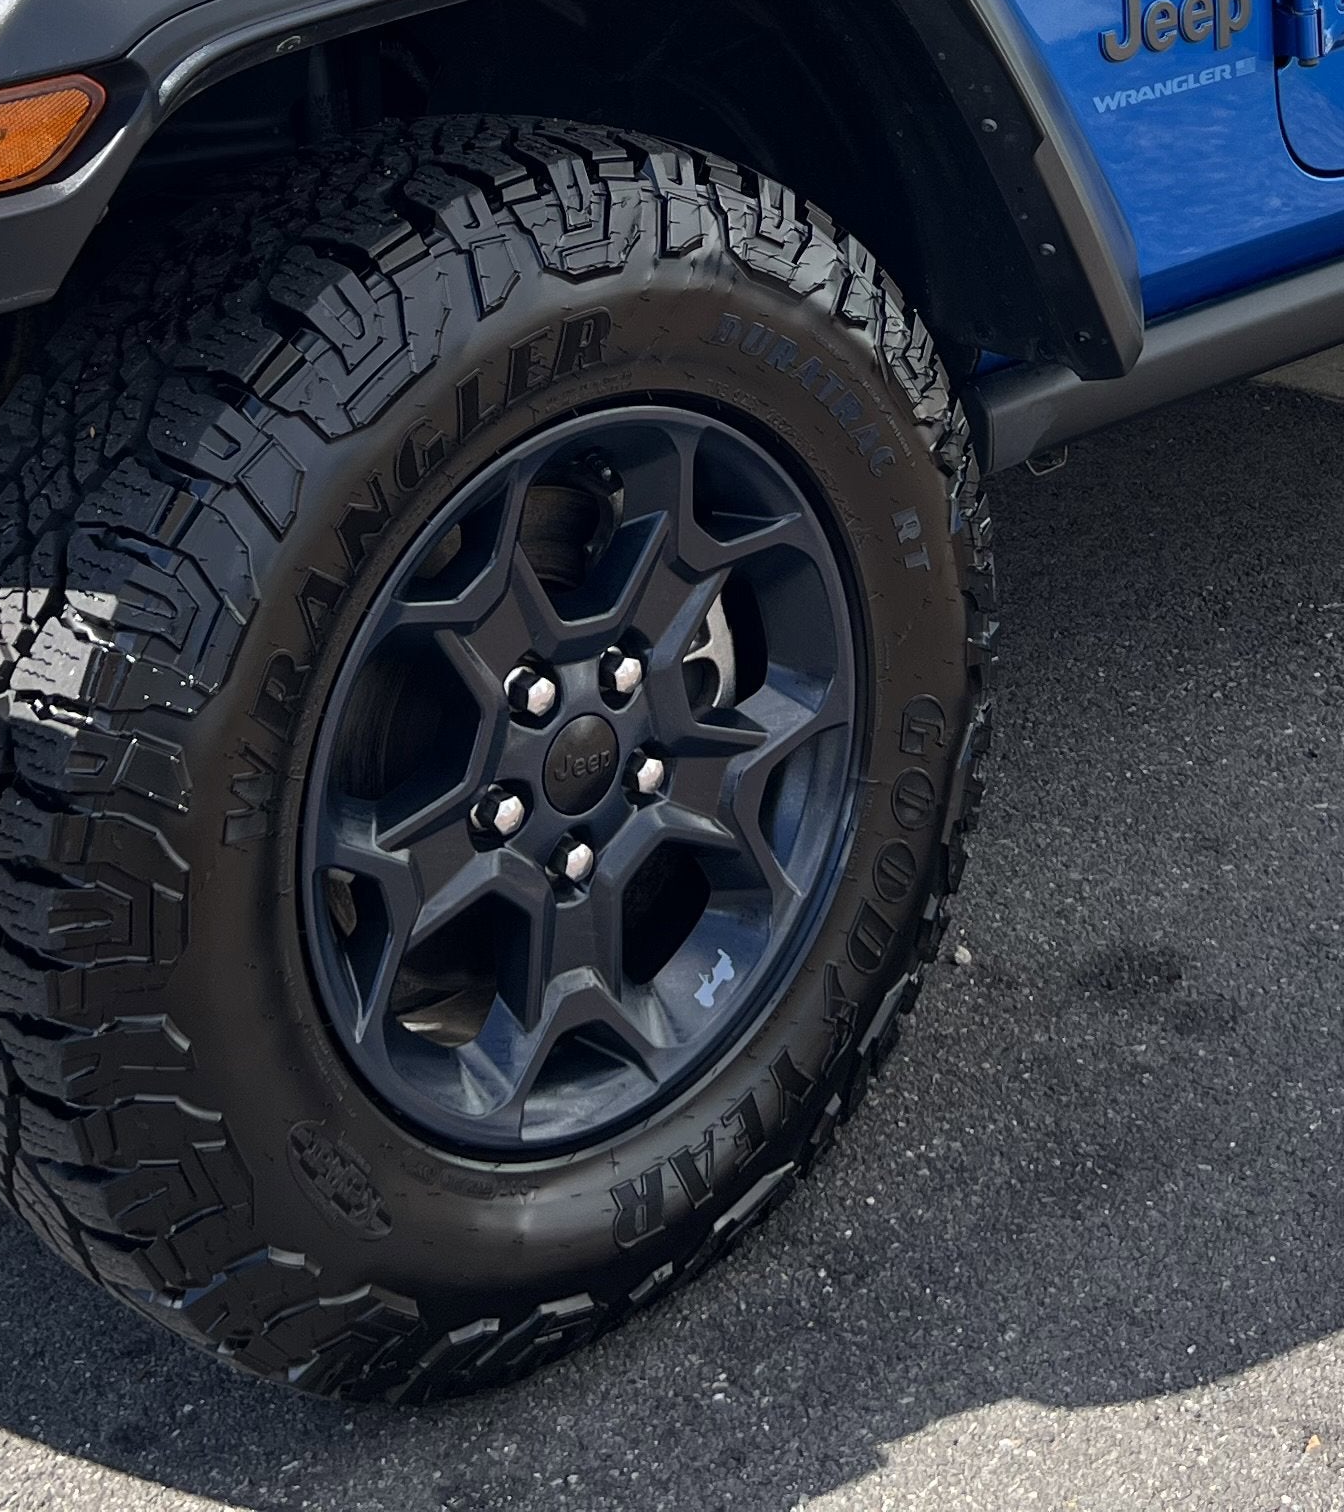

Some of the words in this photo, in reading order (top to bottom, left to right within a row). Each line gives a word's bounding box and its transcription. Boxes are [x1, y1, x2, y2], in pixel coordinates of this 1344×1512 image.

[1092, 63, 1233, 114] WRANGLER
[711, 312, 897, 478] DURATRAC
[890, 506, 932, 572] RT
[223, 305, 612, 847] WRANGLER
[554, 749, 611, 782] Jeep
[609, 692, 947, 1251] GOODYEAR
